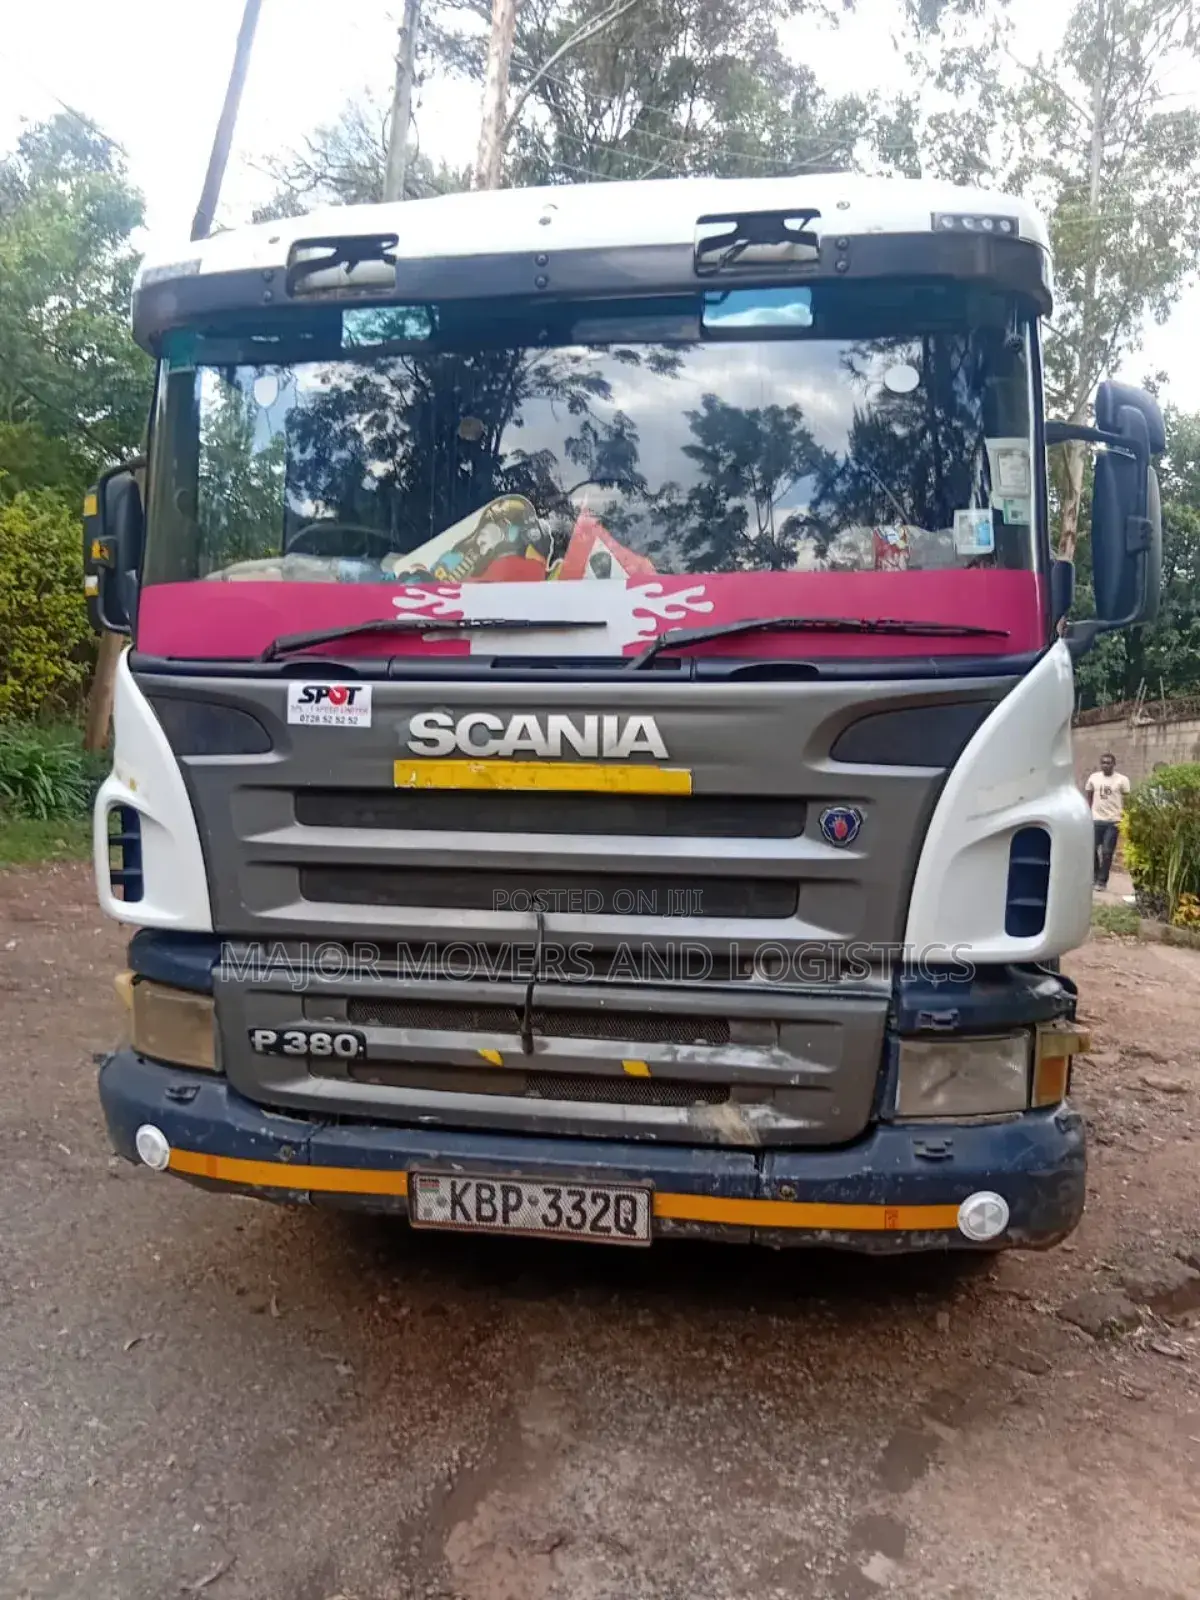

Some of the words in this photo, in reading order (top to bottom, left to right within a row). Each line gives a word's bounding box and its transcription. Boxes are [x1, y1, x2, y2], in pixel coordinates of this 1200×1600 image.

[297, 685, 362, 705] SPOT
[407, 712, 669, 758] SCANIA
[254, 1030, 277, 1052] P
[283, 1031, 358, 1057] 380
[450, 1180, 522, 1224] KBP
[541, 1187, 637, 1235] 332Q
